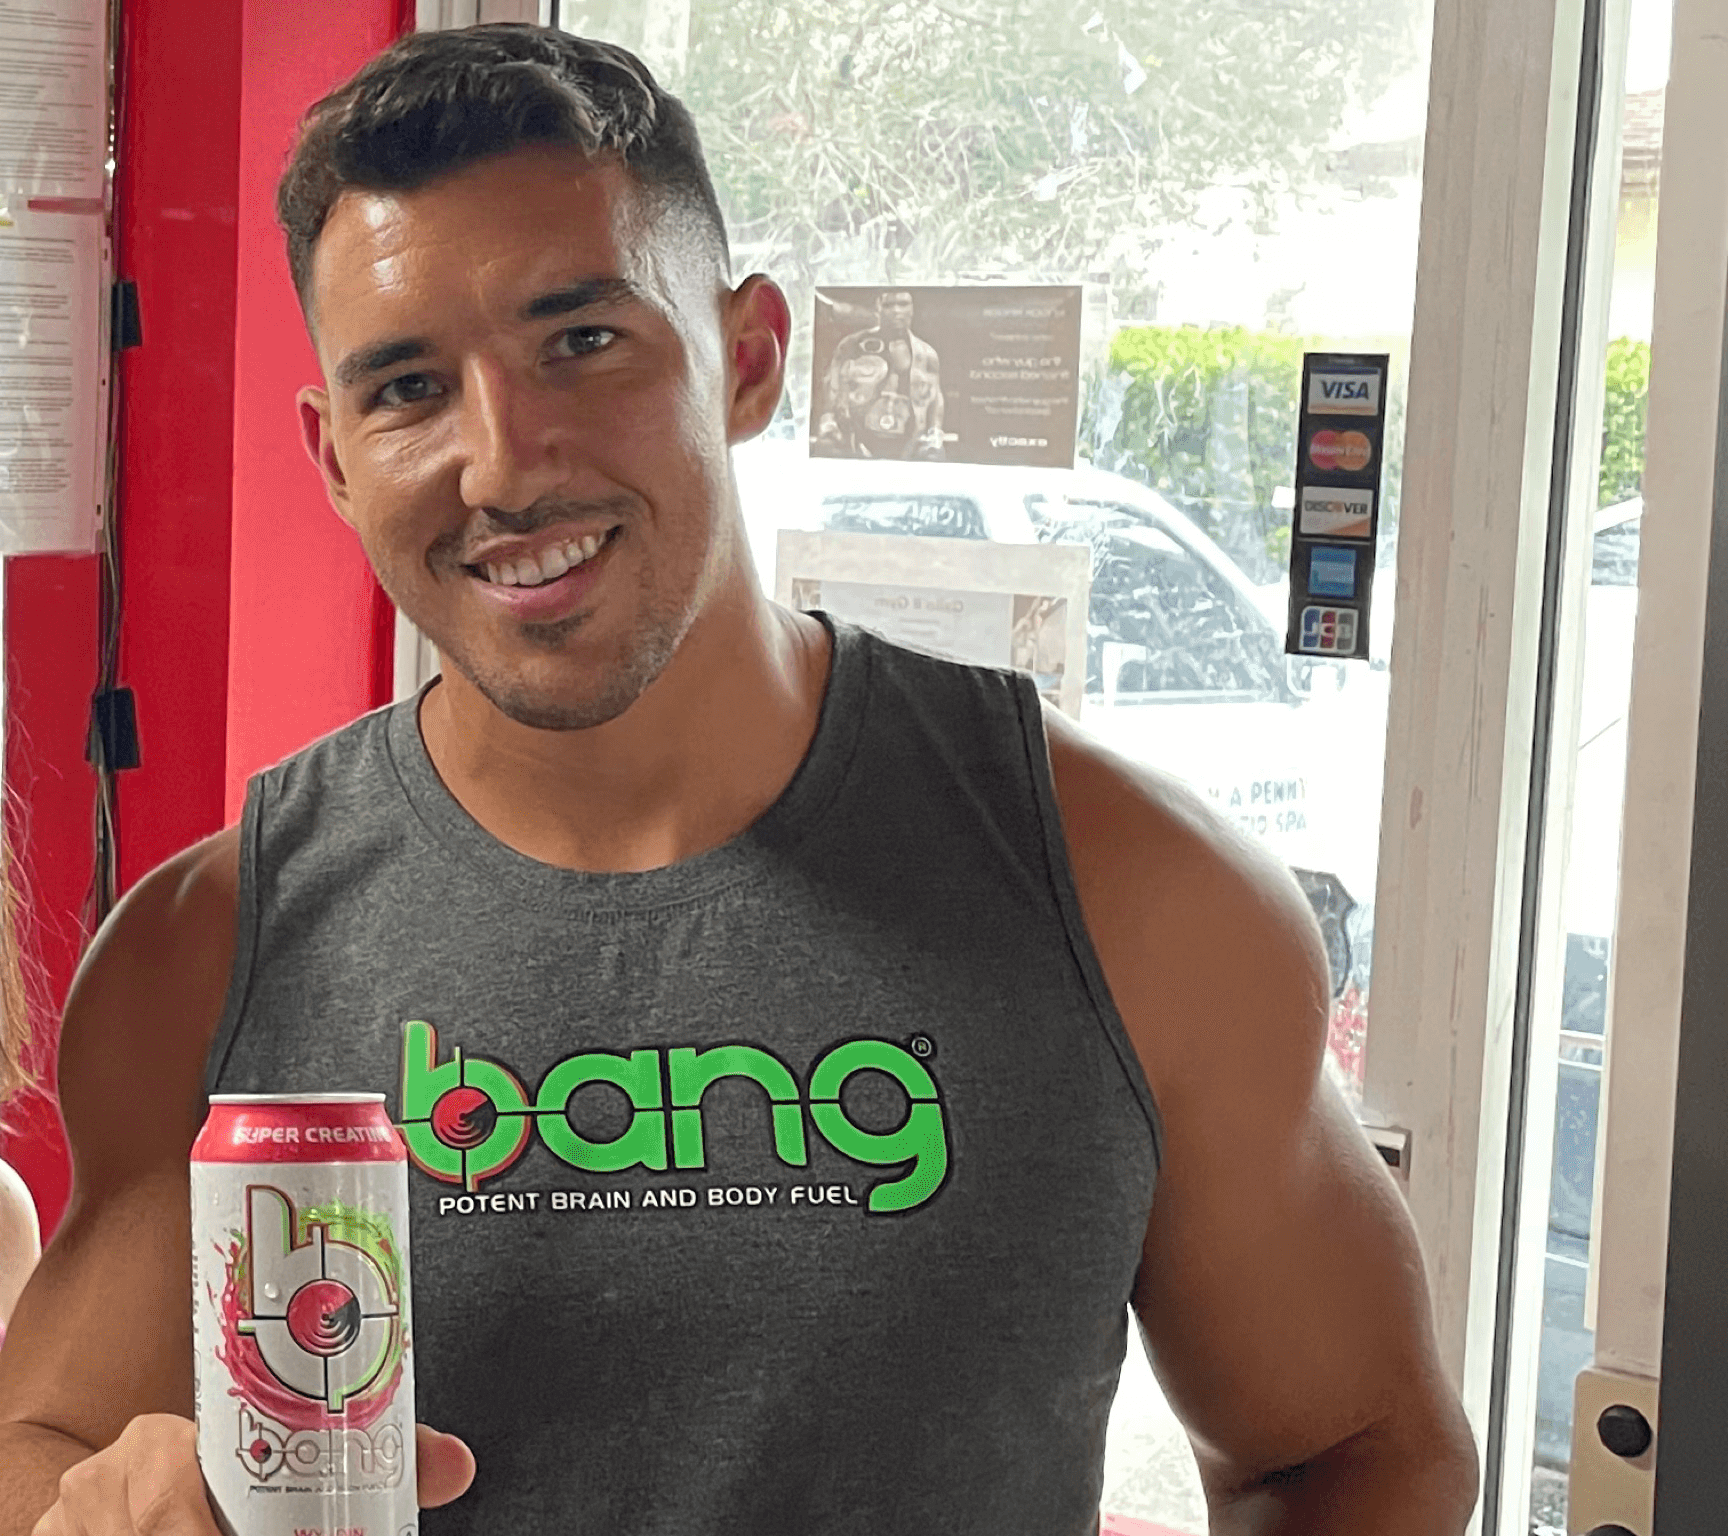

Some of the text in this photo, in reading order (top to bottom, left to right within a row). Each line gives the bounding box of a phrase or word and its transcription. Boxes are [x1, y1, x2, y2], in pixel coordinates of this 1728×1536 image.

[1319, 380, 1370, 401] VISA
[1304, 499, 1368, 515] DISCOVER
[401, 1019, 948, 1212] bang
[233, 1124, 300, 1145] SUPER
[439, 1184, 859, 1216] POTENT BRAIN AND BODY FUEL
